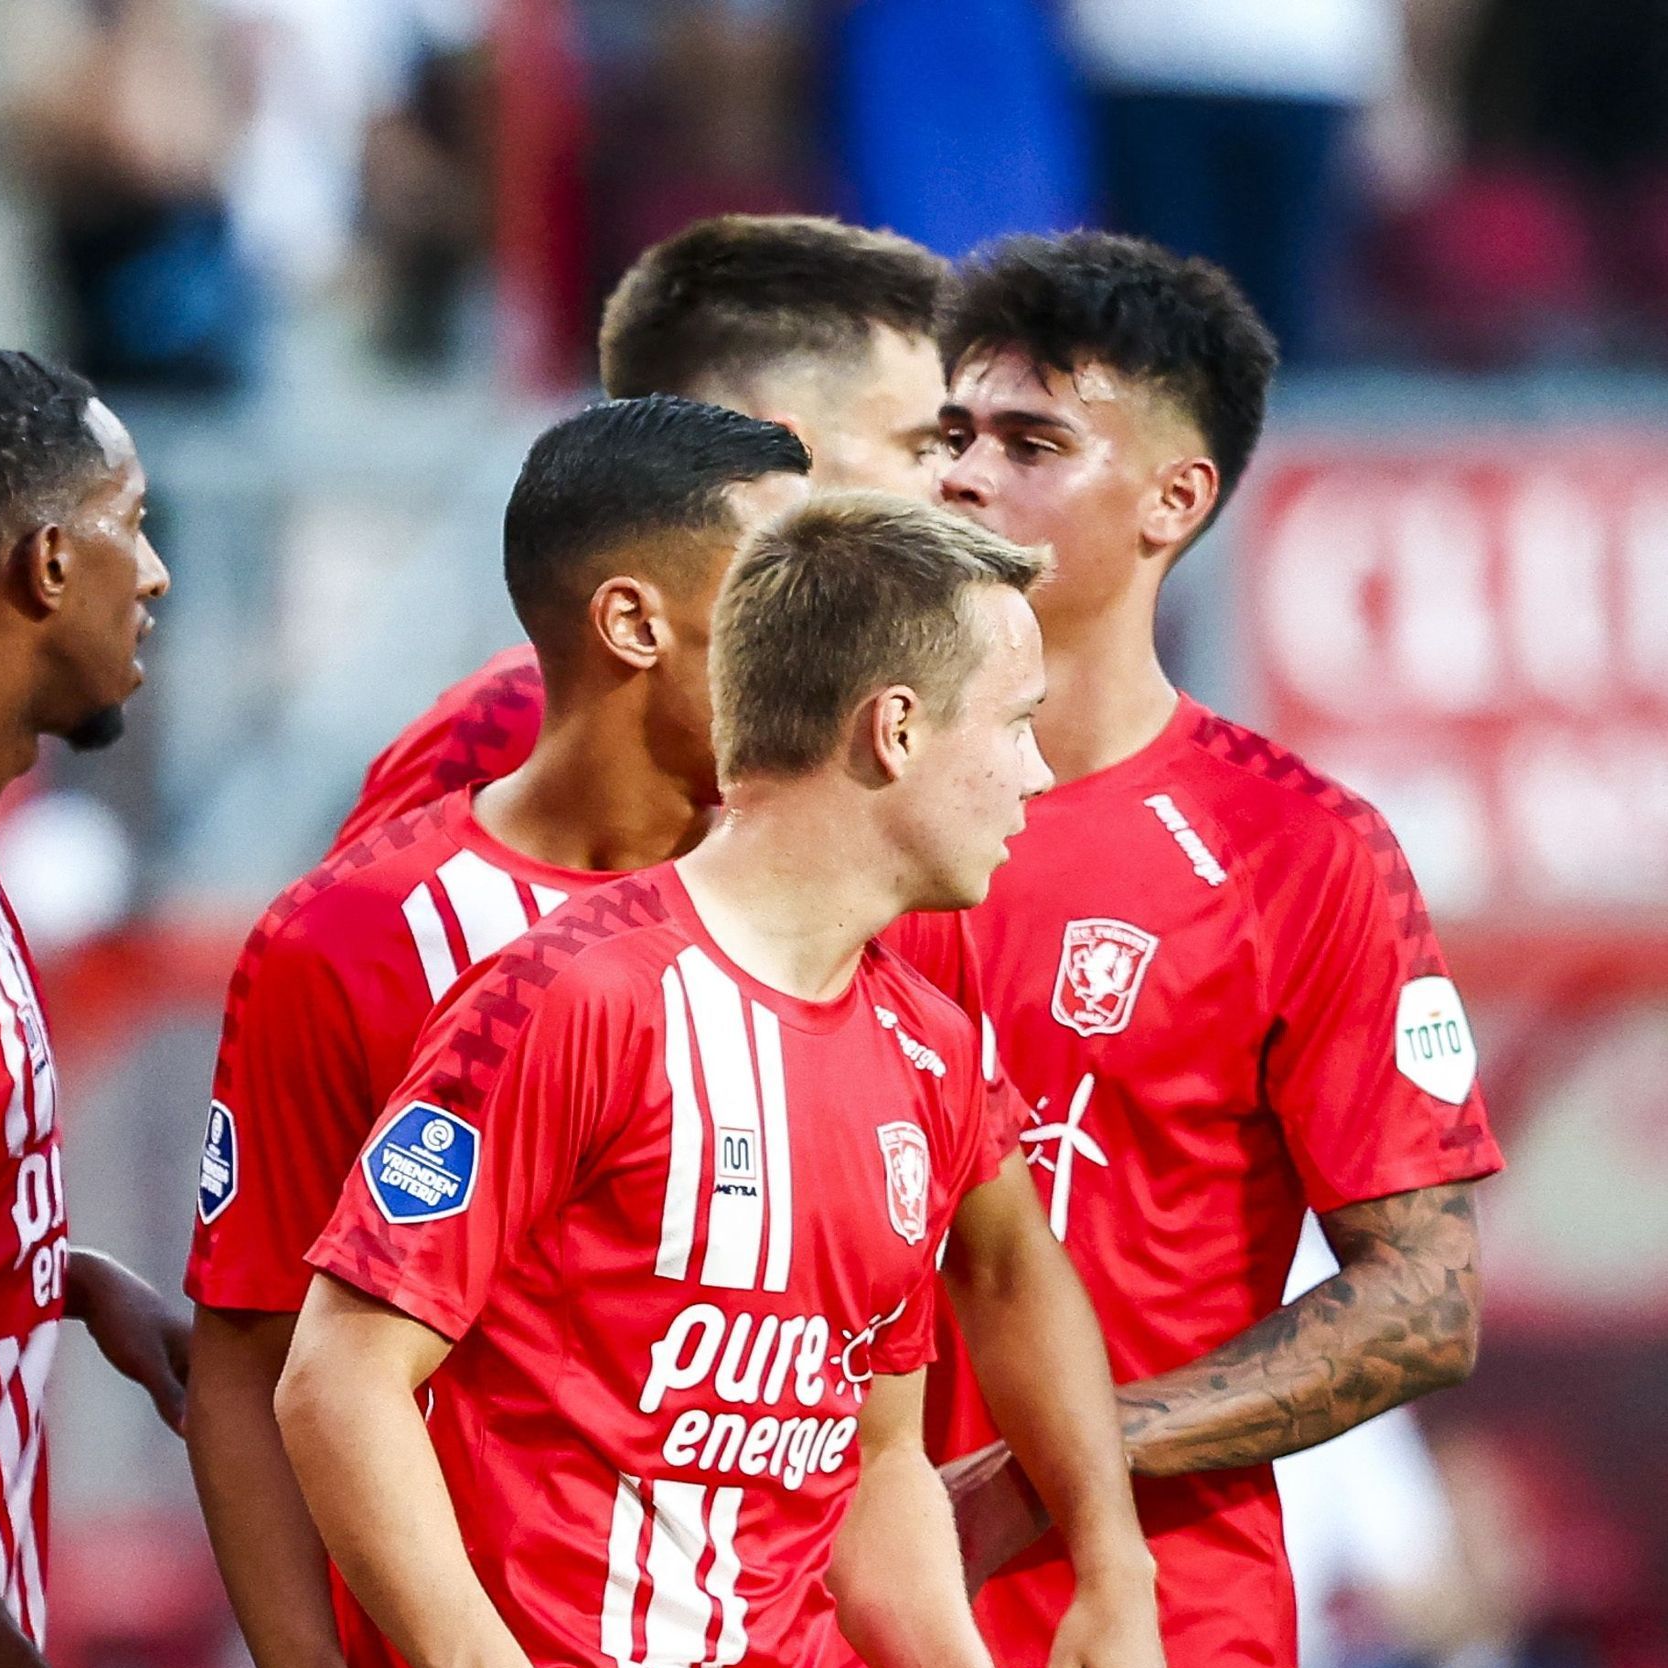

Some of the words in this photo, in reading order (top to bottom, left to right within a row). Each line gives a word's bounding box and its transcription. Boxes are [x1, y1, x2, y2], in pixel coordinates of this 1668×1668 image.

[1404, 1020, 1462, 1061] TOTO
[380, 1166, 443, 1206] LOTERIJ
[382, 1148, 460, 1198] VRIENDEN
[713, 1183, 757, 1197] MEYBA
[638, 1303, 830, 1414] pure
[662, 1409, 858, 1490] energie
